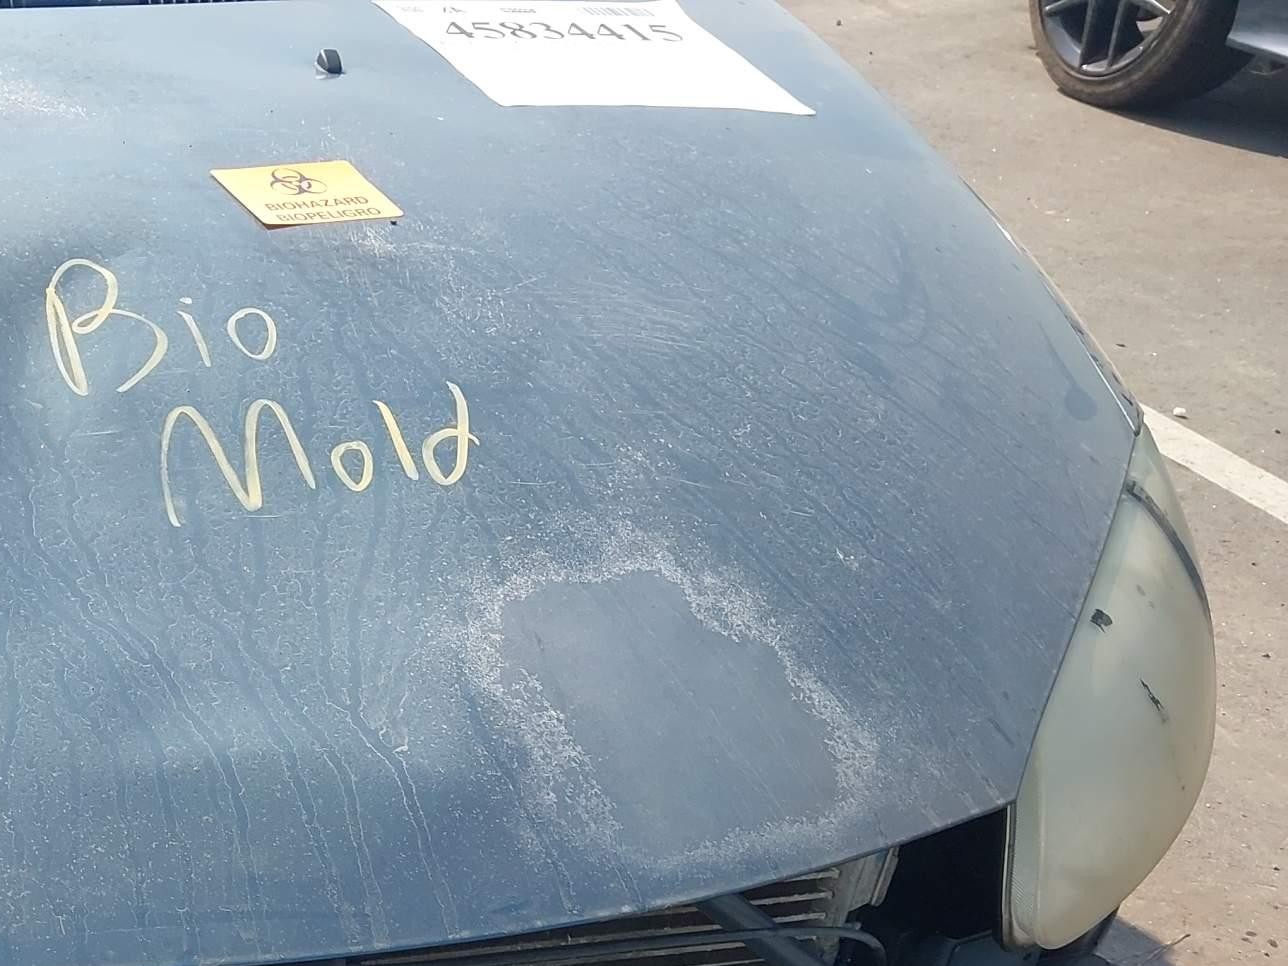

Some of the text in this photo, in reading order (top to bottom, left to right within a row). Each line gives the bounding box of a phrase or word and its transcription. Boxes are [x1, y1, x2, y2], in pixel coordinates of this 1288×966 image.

[445, 21, 684, 42] 45834415
[264, 196, 369, 212] BIOHAZARD
[275, 207, 381, 222] BIOPELIGRO
[45, 258, 278, 396] Bio
[160, 381, 480, 527] Mold
